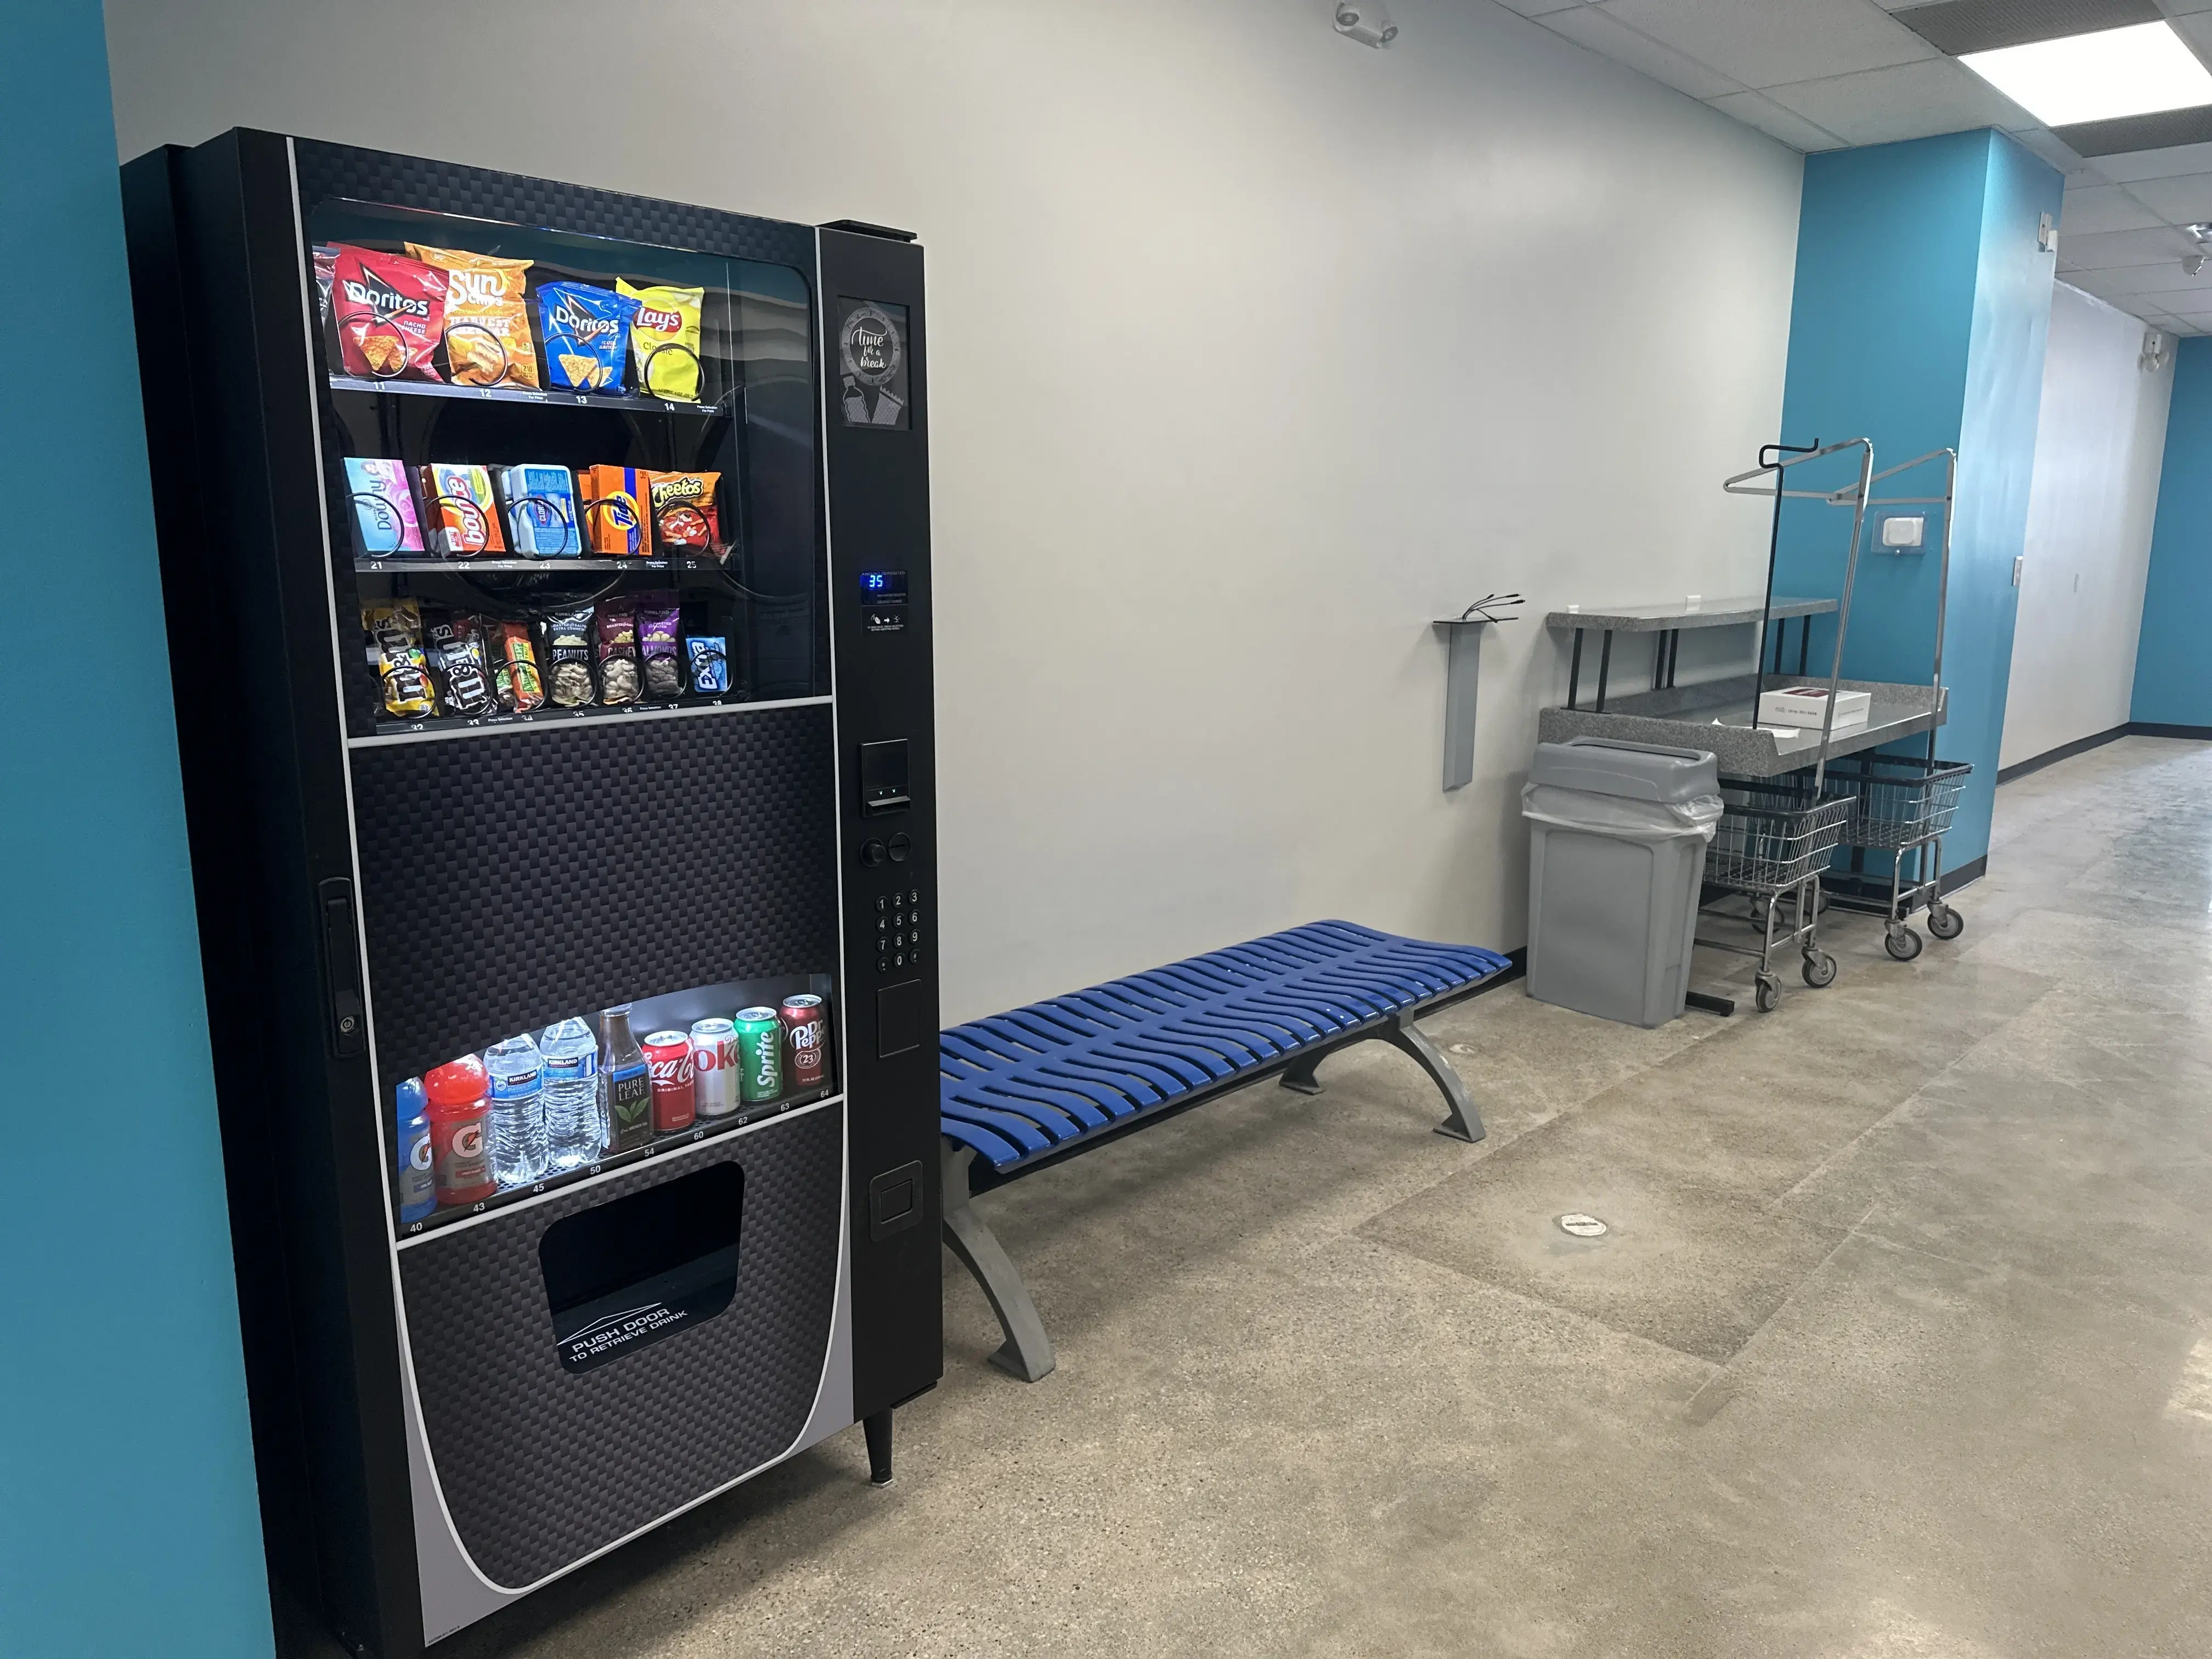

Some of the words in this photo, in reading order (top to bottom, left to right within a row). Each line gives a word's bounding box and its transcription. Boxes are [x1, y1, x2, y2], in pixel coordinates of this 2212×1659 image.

[447, 269, 507, 305] Sun
[347, 281, 429, 315] Doritos
[404, 320, 426, 329] NACHO
[556, 306, 619, 334] Doritos
[636, 307, 679, 332] Lay's
[860, 357, 887, 369] break
[373, 382, 385, 390] 11
[479, 388, 492, 397] 12
[576, 396, 587, 404] 13
[664, 403, 675, 411] 14
[652, 477, 701, 507] Cheetos
[370, 561, 382, 569] 21
[458, 561, 470, 569] 22
[539, 561, 551, 569] 23
[869, 574, 883, 588] 35
[552, 649, 589, 661] PEANUTS
[641, 645, 677, 657] ALMONDS
[879, 899, 884, 909] 1
[896, 895, 901, 905] 2
[912, 892, 917, 902] 3
[879, 919, 885, 929] 4
[896, 915, 901, 926] 5
[912, 912, 917, 922] 6
[881, 940, 885, 950] 7
[896, 936, 901, 946] 8
[912, 932, 918, 942] 9
[897, 956, 902, 966] 0
[807, 1019, 823, 1036] Dr
[757, 1031, 778, 1087] Sprite
[803, 1054, 814, 1064] 23
[509, 1070, 537, 1083] KIRKLAND
[618, 1077, 645, 1093] PURE
[618, 1086, 645, 1102] LEAF
[820, 1090, 830, 1098] 64
[780, 1103, 790, 1111] 63
[738, 1116, 748, 1125] 62
[452, 1122, 484, 1159] G
[693, 1131, 704, 1141] 60
[644, 1147, 655, 1157] 54
[590, 1164, 601, 1175] 50
[532, 1183, 545, 1193] 45
[473, 1202, 486, 1212] 43
[410, 1222, 423, 1234] 40
[569, 1352, 588, 1362] TO
[590, 1327, 648, 1355] RETRIEVE
[649, 1310, 688, 1330] DRINK
[572, 1328, 620, 1352] PUSH
[623, 1308, 670, 1331] DOOR
